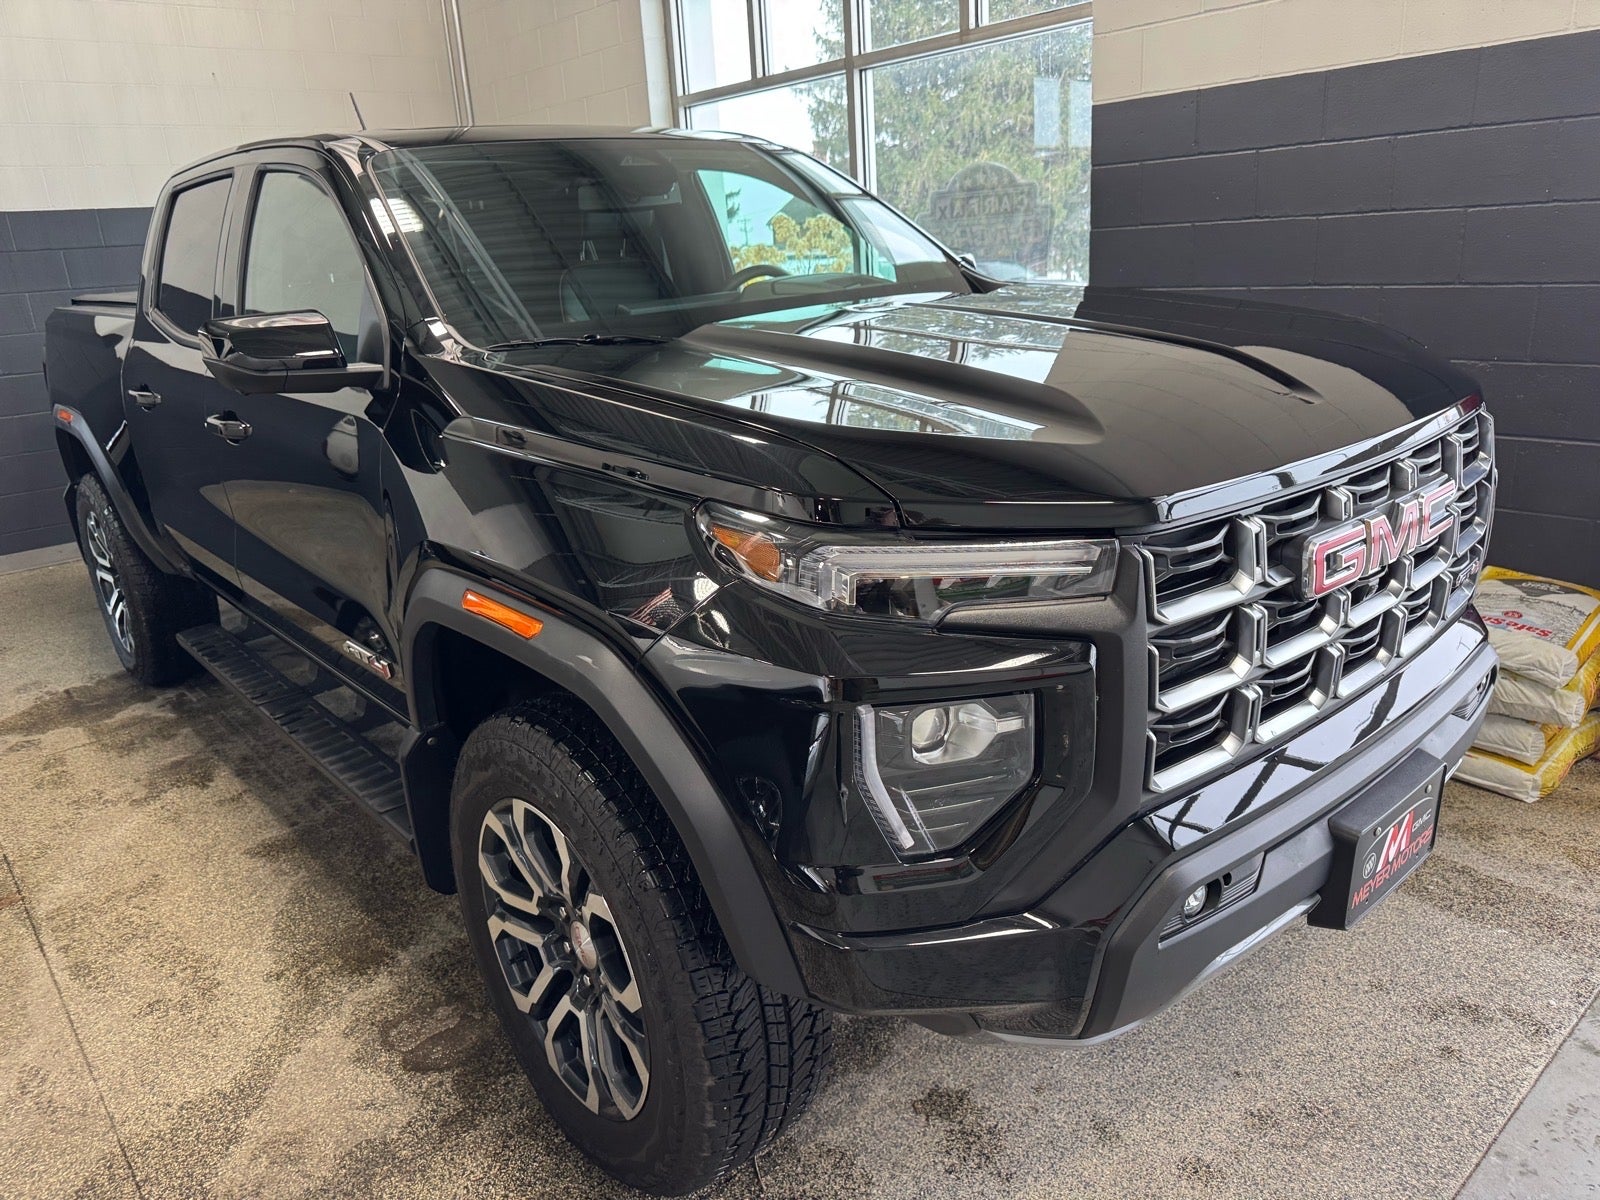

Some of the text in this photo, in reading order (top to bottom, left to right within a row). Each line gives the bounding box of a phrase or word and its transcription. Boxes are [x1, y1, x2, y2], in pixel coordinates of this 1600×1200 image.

[1310, 480, 1456, 599] GMC
[1412, 808, 1432, 832] GMC
[1351, 824, 1434, 910] MEYER MOTORS
